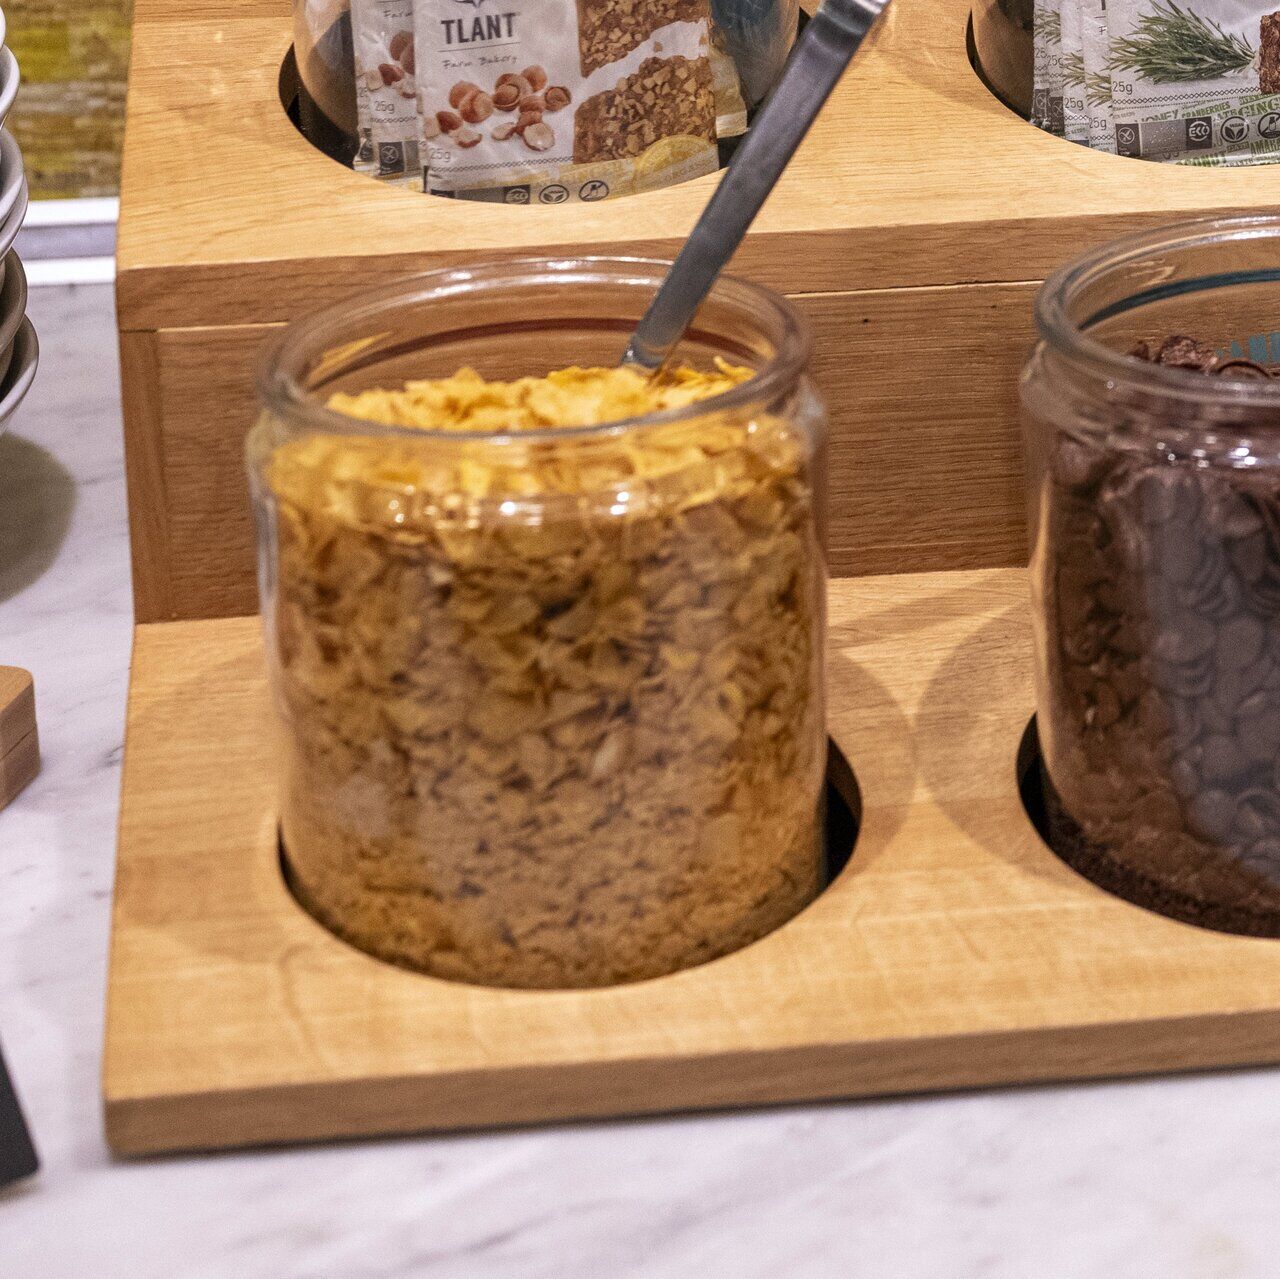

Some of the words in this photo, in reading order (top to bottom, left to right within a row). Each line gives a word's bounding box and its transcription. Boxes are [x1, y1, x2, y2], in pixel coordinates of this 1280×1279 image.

[440, 12, 518, 44] TLANT
[442, 59, 473, 70] Farm
[1112, 80, 1133, 95] 25g
[374, 100, 395, 114] 25g
[1064, 97, 1084, 110] 25g
[1181, 100, 1231, 119] CRANBERRIES
[1088, 118, 1107, 131] 25g
[429, 147, 450, 163] 25g
